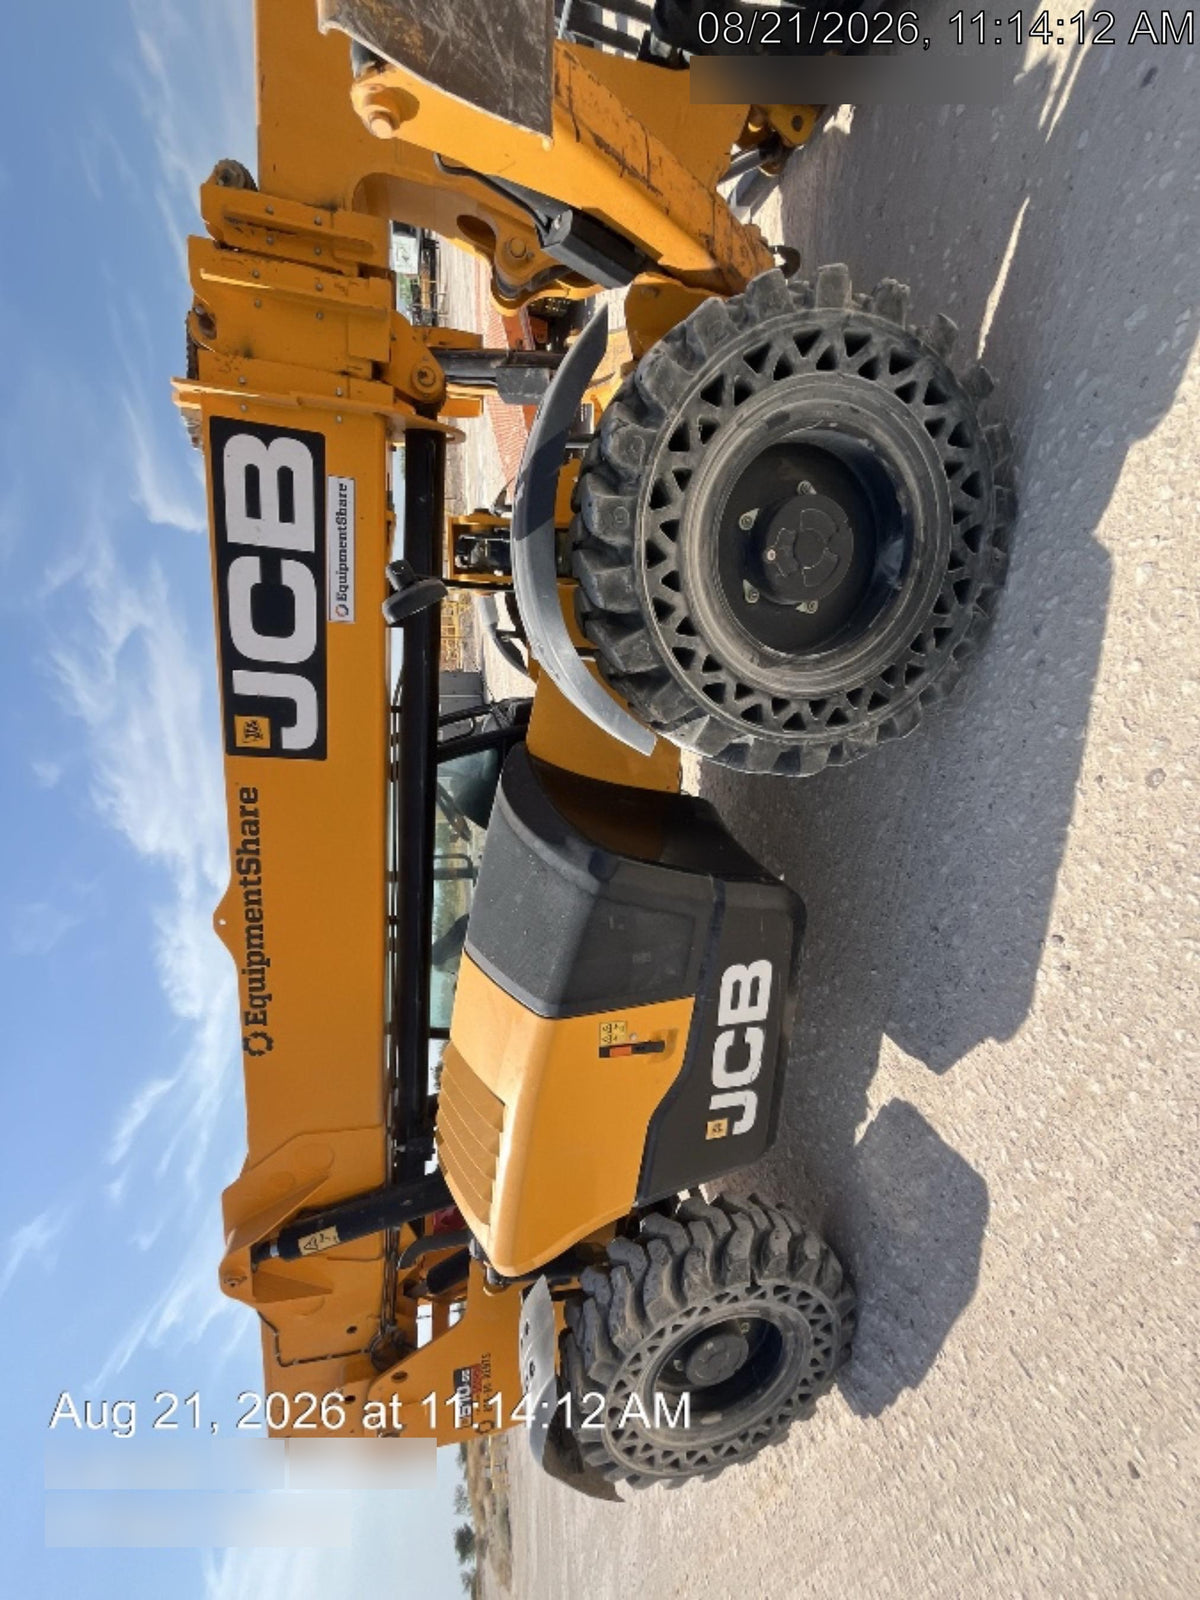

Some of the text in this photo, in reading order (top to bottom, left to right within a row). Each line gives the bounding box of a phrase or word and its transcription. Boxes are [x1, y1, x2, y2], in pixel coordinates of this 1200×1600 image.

[223, 433, 318, 750] JCB
[335, 482, 349, 602] EquipmentShare
[235, 787, 272, 1026] EquipmentShare
[709, 959, 772, 1135] JCB
